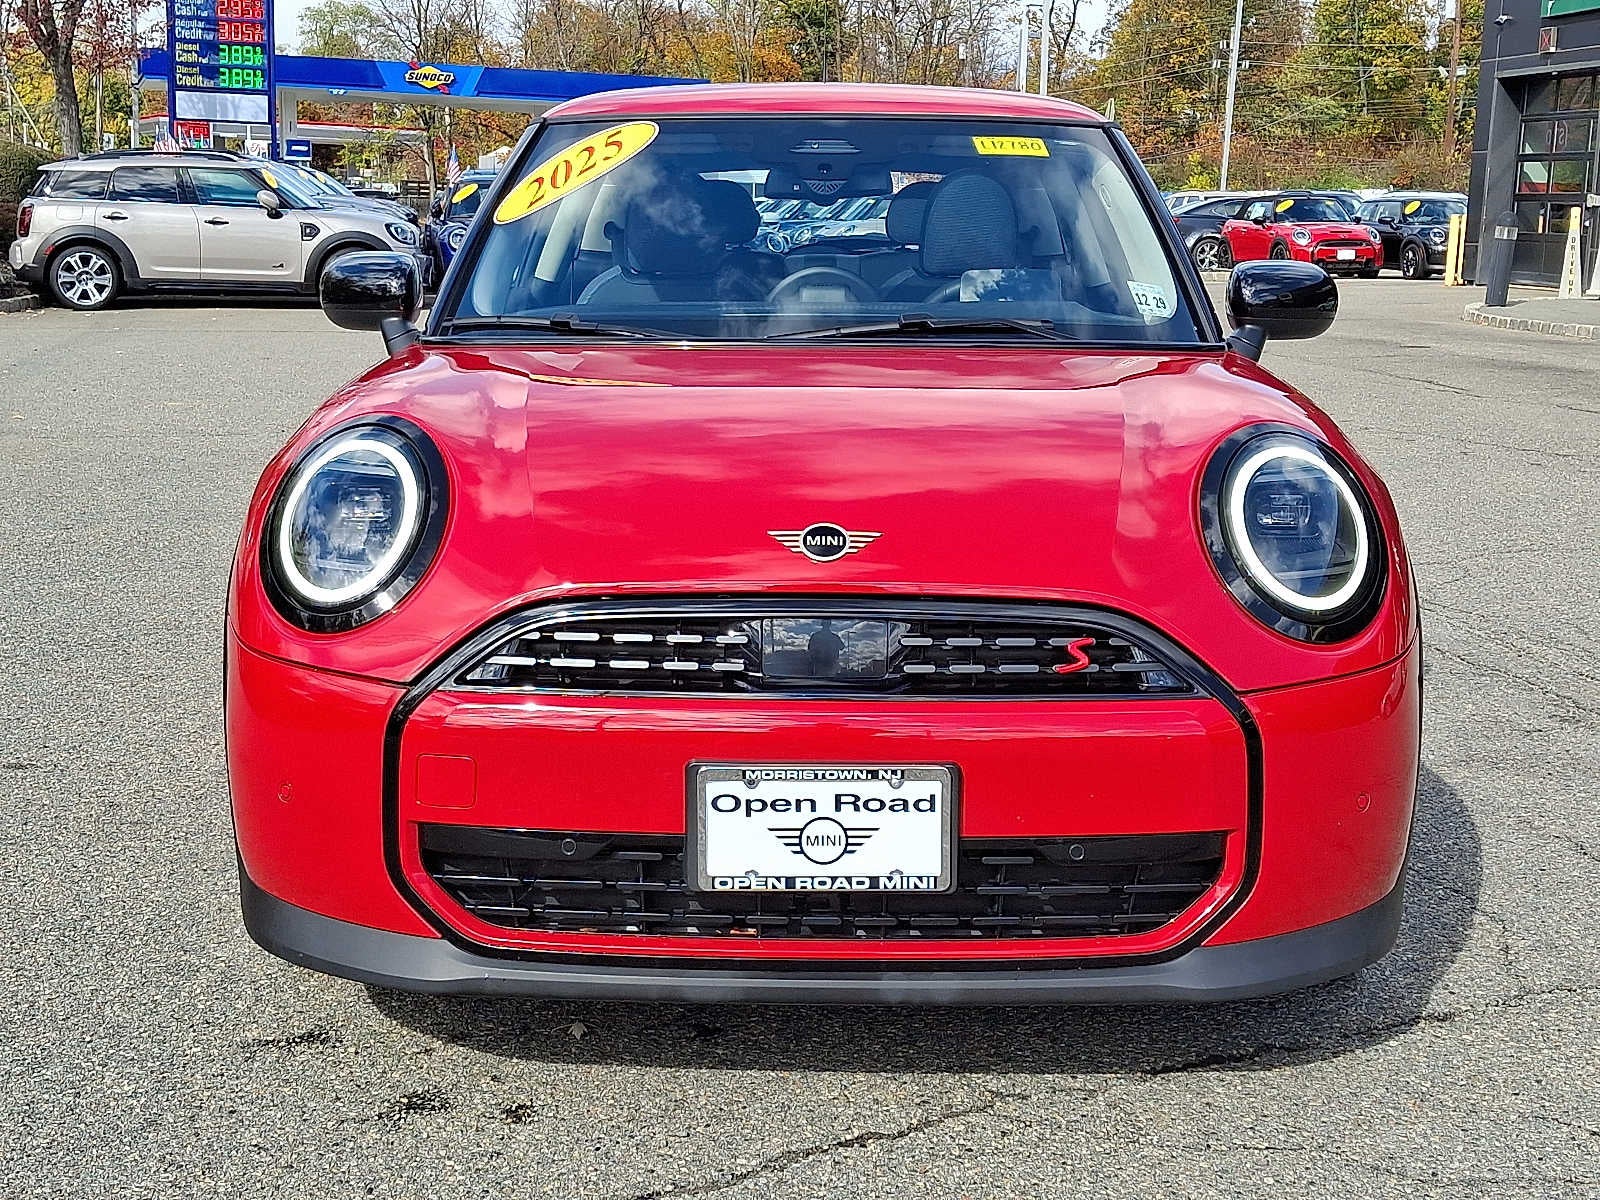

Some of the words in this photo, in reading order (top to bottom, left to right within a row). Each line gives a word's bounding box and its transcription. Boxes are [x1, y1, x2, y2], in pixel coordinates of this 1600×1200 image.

[175, 3, 197, 16] Cash
[175, 18, 205, 28] Regular
[175, 27, 202, 40] Credit
[175, 42, 199, 51] Diesel
[175, 51, 198, 63] Cash
[176, 65, 200, 74] Diesel
[176, 74, 203, 87] Credit
[407, 71, 452, 82] SUNOCO
[526, 129, 623, 210] 2025
[1568, 280, 1575, 295] UP
[1135, 293, 1151, 307] 12
[1152, 296, 1167, 309] 29
[806, 535, 844, 547] MINI
[1054, 637, 1096, 675] S
[878, 769, 902, 781] NJ
[710, 793, 817, 818] Open
[833, 793, 937, 814] Road
[805, 834, 842, 847] MINI
[713, 876, 786, 890] OPEN
[795, 876, 870, 890] ROAD
[878, 876, 936, 890] MINI
